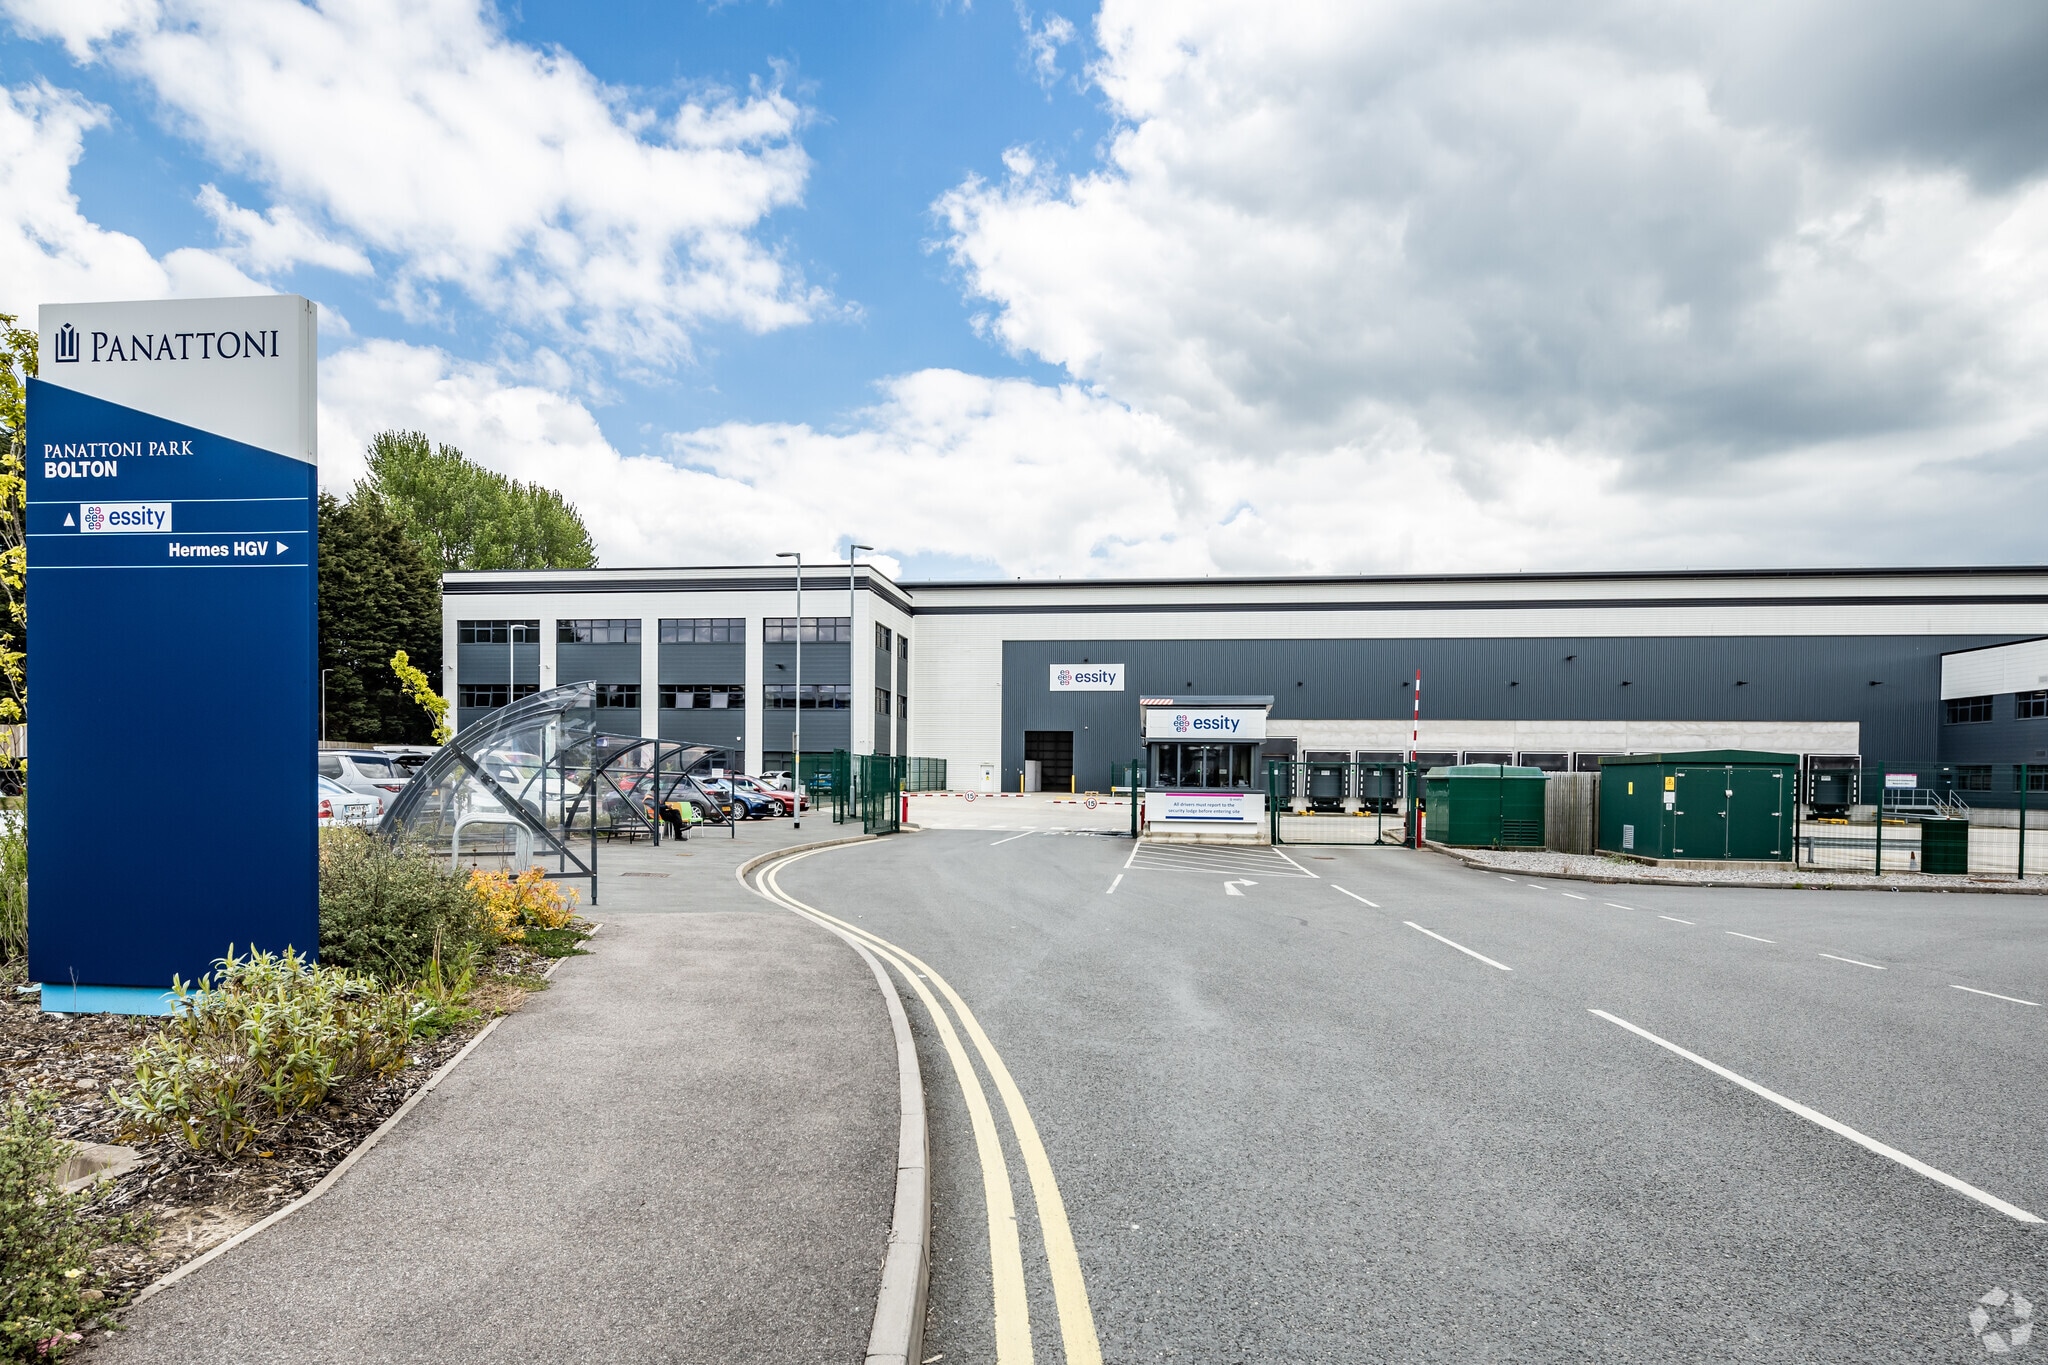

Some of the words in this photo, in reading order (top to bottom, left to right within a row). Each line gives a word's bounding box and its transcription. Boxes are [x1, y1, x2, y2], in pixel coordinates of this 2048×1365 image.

[91, 330, 279, 362] PANATTONI
[44, 441, 142, 459] PANATTONI
[149, 440, 194, 456] PARK
[44, 460, 118, 479] BOLTON
[109, 505, 166, 529] essity
[168, 541, 229, 557] Hermes
[233, 541, 268, 556] HGV
[1075, 669, 1117, 686] essity
[1193, 714, 1240, 733] essity
